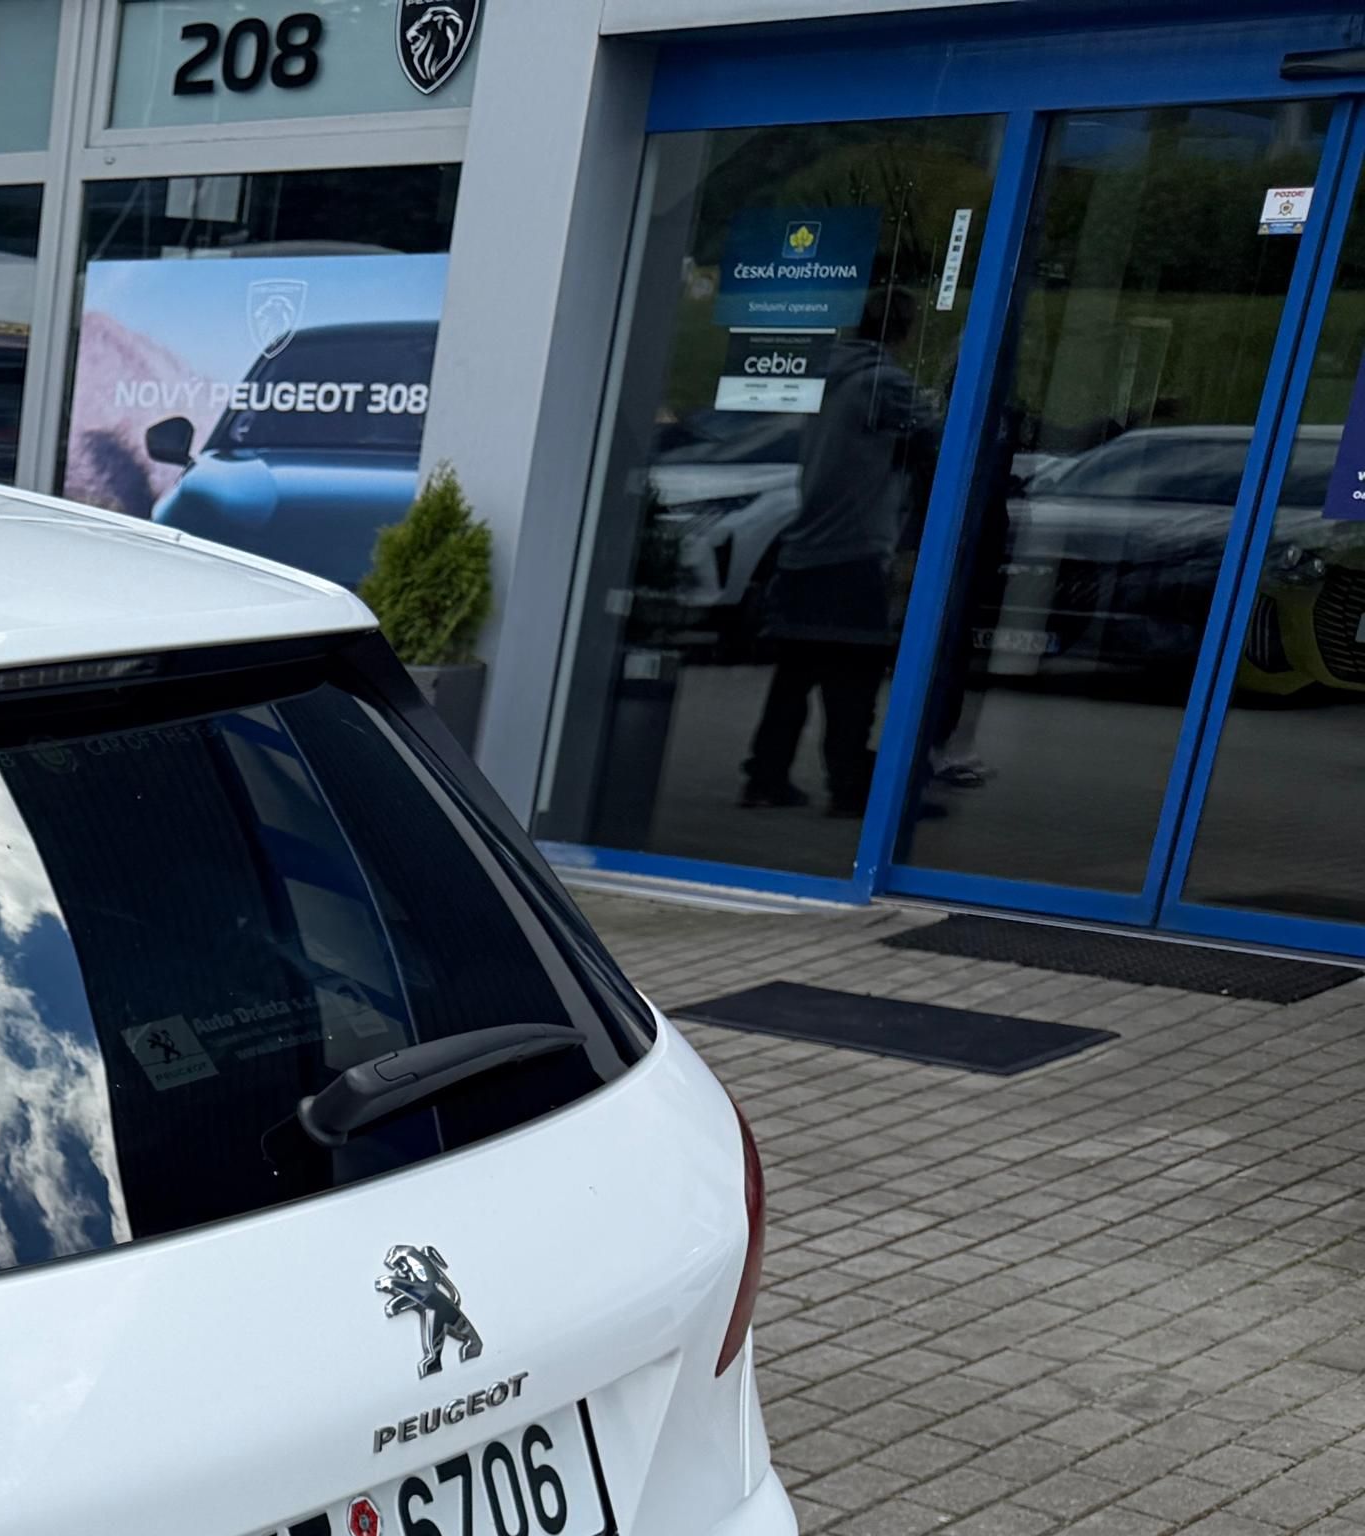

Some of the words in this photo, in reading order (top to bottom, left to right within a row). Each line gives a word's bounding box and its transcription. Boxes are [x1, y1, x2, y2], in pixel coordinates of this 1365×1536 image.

[173, 12, 324, 96] 208
[733, 262, 775, 279] ČESKÁ
[777, 261, 858, 279] POJIŠŤOVNA
[744, 351, 808, 375] cebia
[114, 376, 205, 407] NOVÝ
[206, 382, 364, 412] PEUGEOT
[366, 382, 429, 413] 308
[192, 1014, 235, 1036] Auto
[373, 1371, 529, 1454] PEUGEOT
